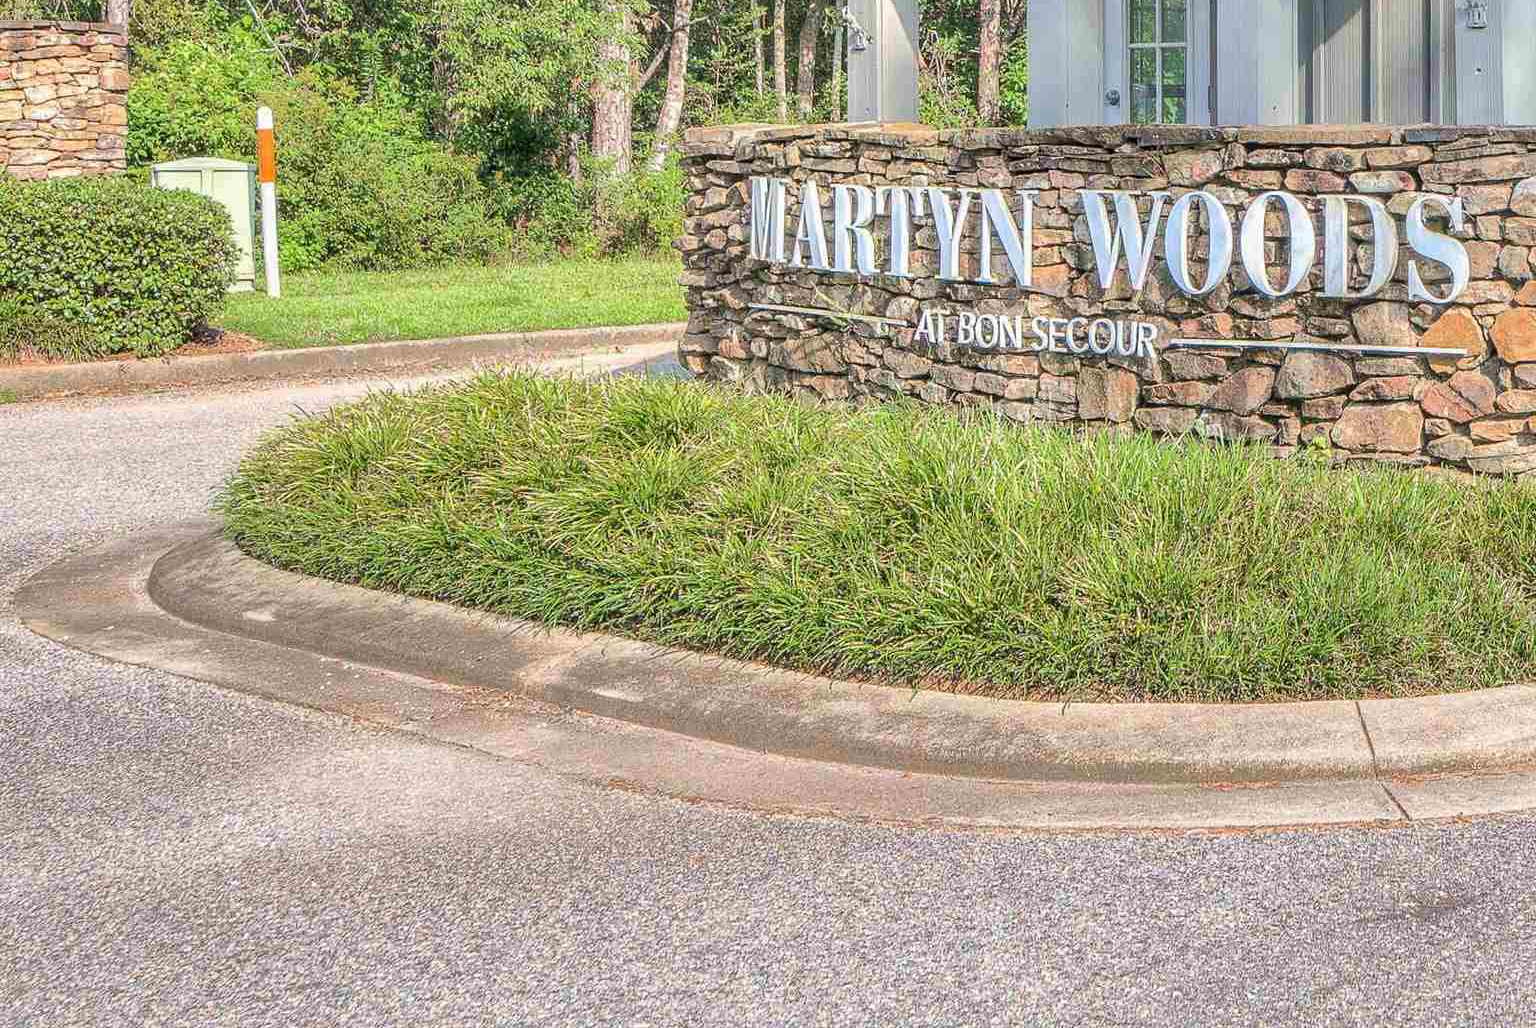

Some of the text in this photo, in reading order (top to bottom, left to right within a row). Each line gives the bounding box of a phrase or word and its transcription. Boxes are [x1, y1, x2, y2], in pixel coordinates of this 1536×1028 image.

[749, 175, 1474, 304] MARTYN WOODS
[913, 308, 1159, 357] AT BON SECOUR
